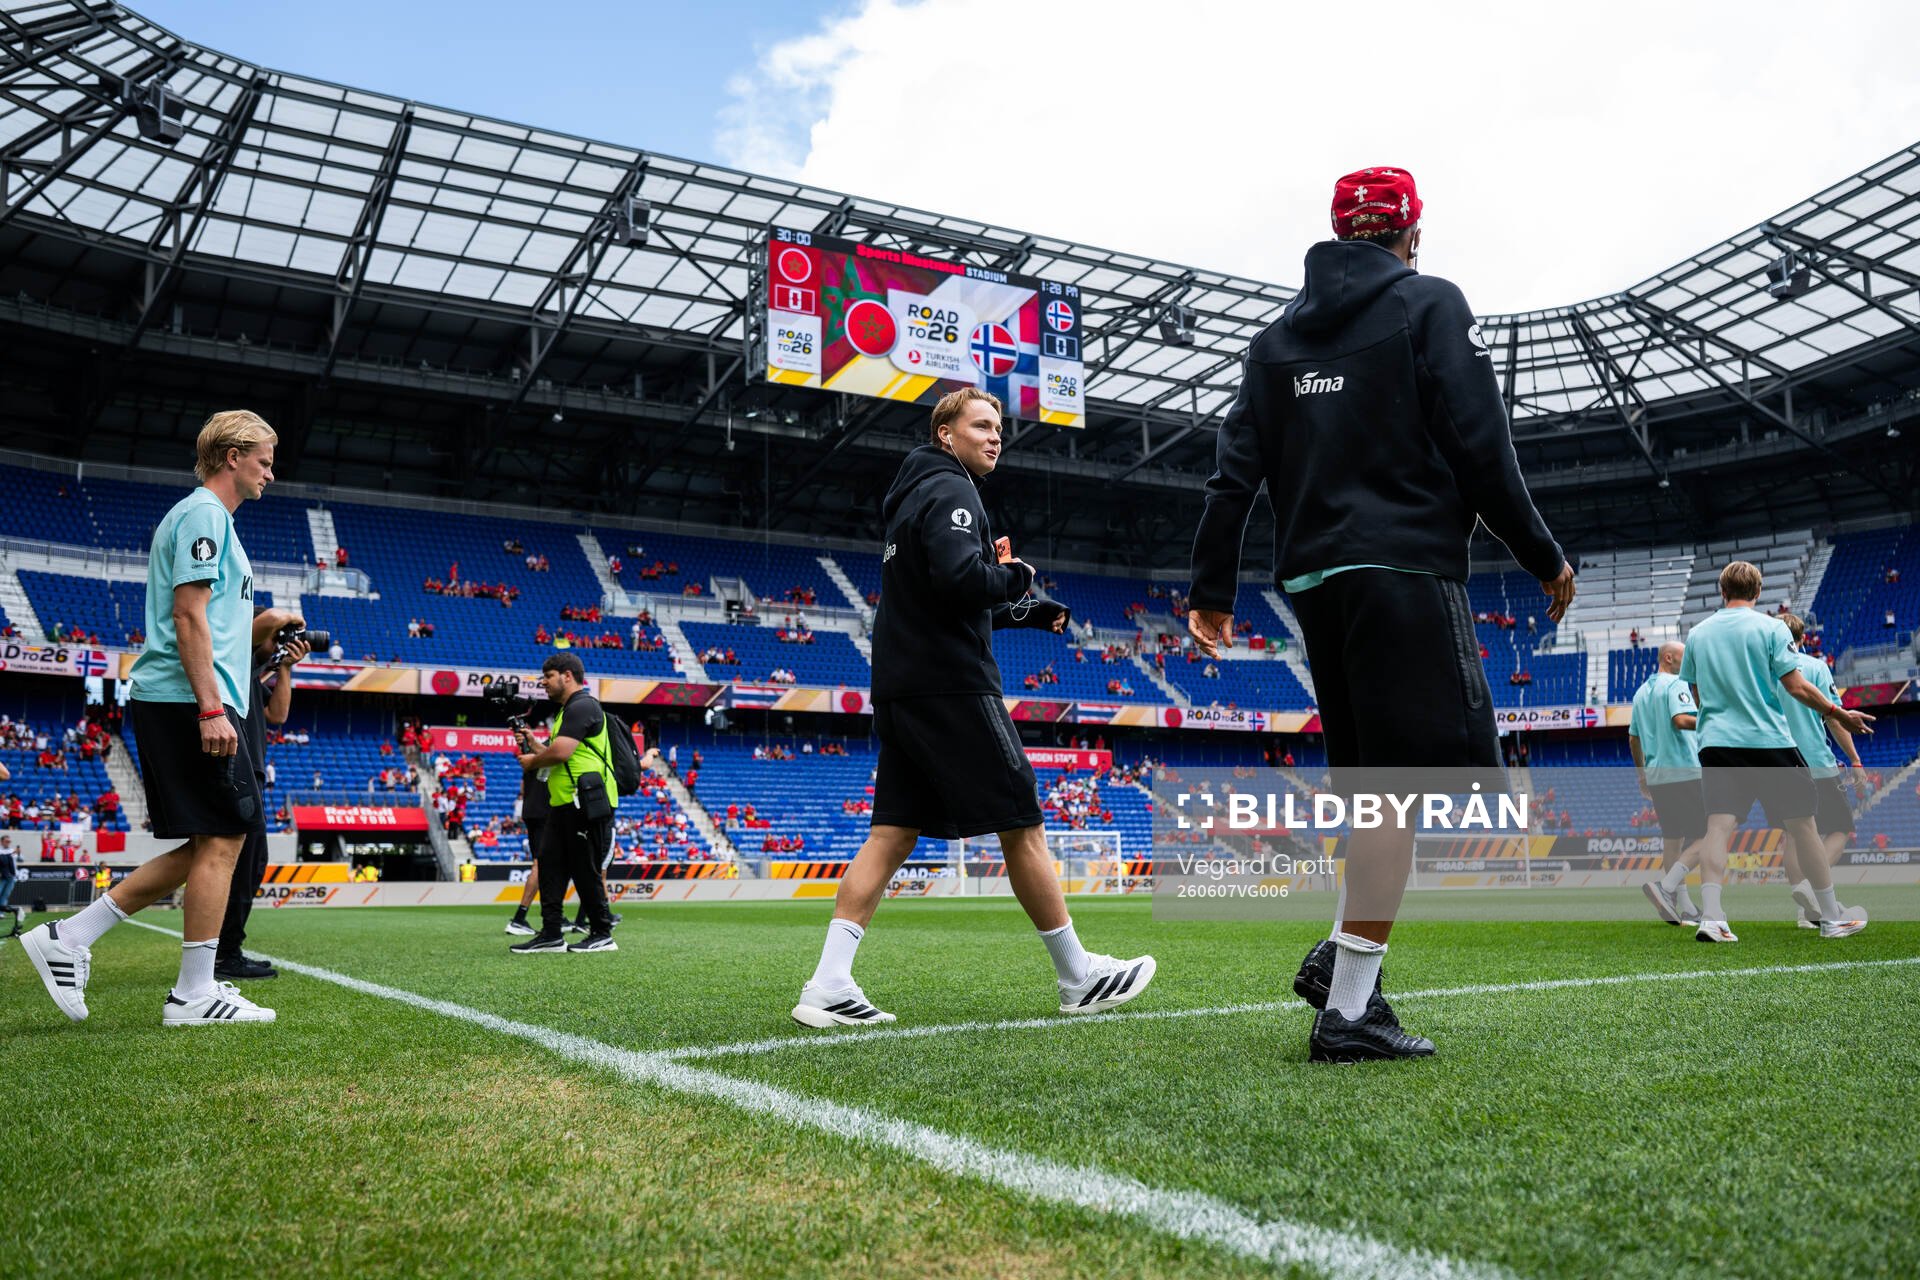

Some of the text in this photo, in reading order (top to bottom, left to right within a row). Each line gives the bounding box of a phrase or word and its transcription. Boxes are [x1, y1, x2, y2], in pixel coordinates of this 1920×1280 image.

[777, 228, 812, 246] 30:00
[856, 243, 901, 264] Sports
[966, 267, 1008, 284] STADIUM
[1041, 280, 1062, 295] 1:28
[789, 287, 802, 311] 0
[907, 303, 959, 325] ROAD
[777, 328, 813, 343] ROAD
[925, 352, 960, 364] TURKISH
[924, 360, 960, 372] AIRLINES
[1047, 373, 1077, 387] ROAD
[1186, 709, 1221, 722] ROAD
[1496, 711, 1539, 723] ROAD
[471, 733, 504, 747] FROM
[1054, 752, 1078, 764] STATE
[324, 806, 394, 817] Red Bull
[326, 815, 397, 825] NEW YORK
[1587, 837, 1637, 853] ROAD
[1850, 852, 1885, 864] ROAD
